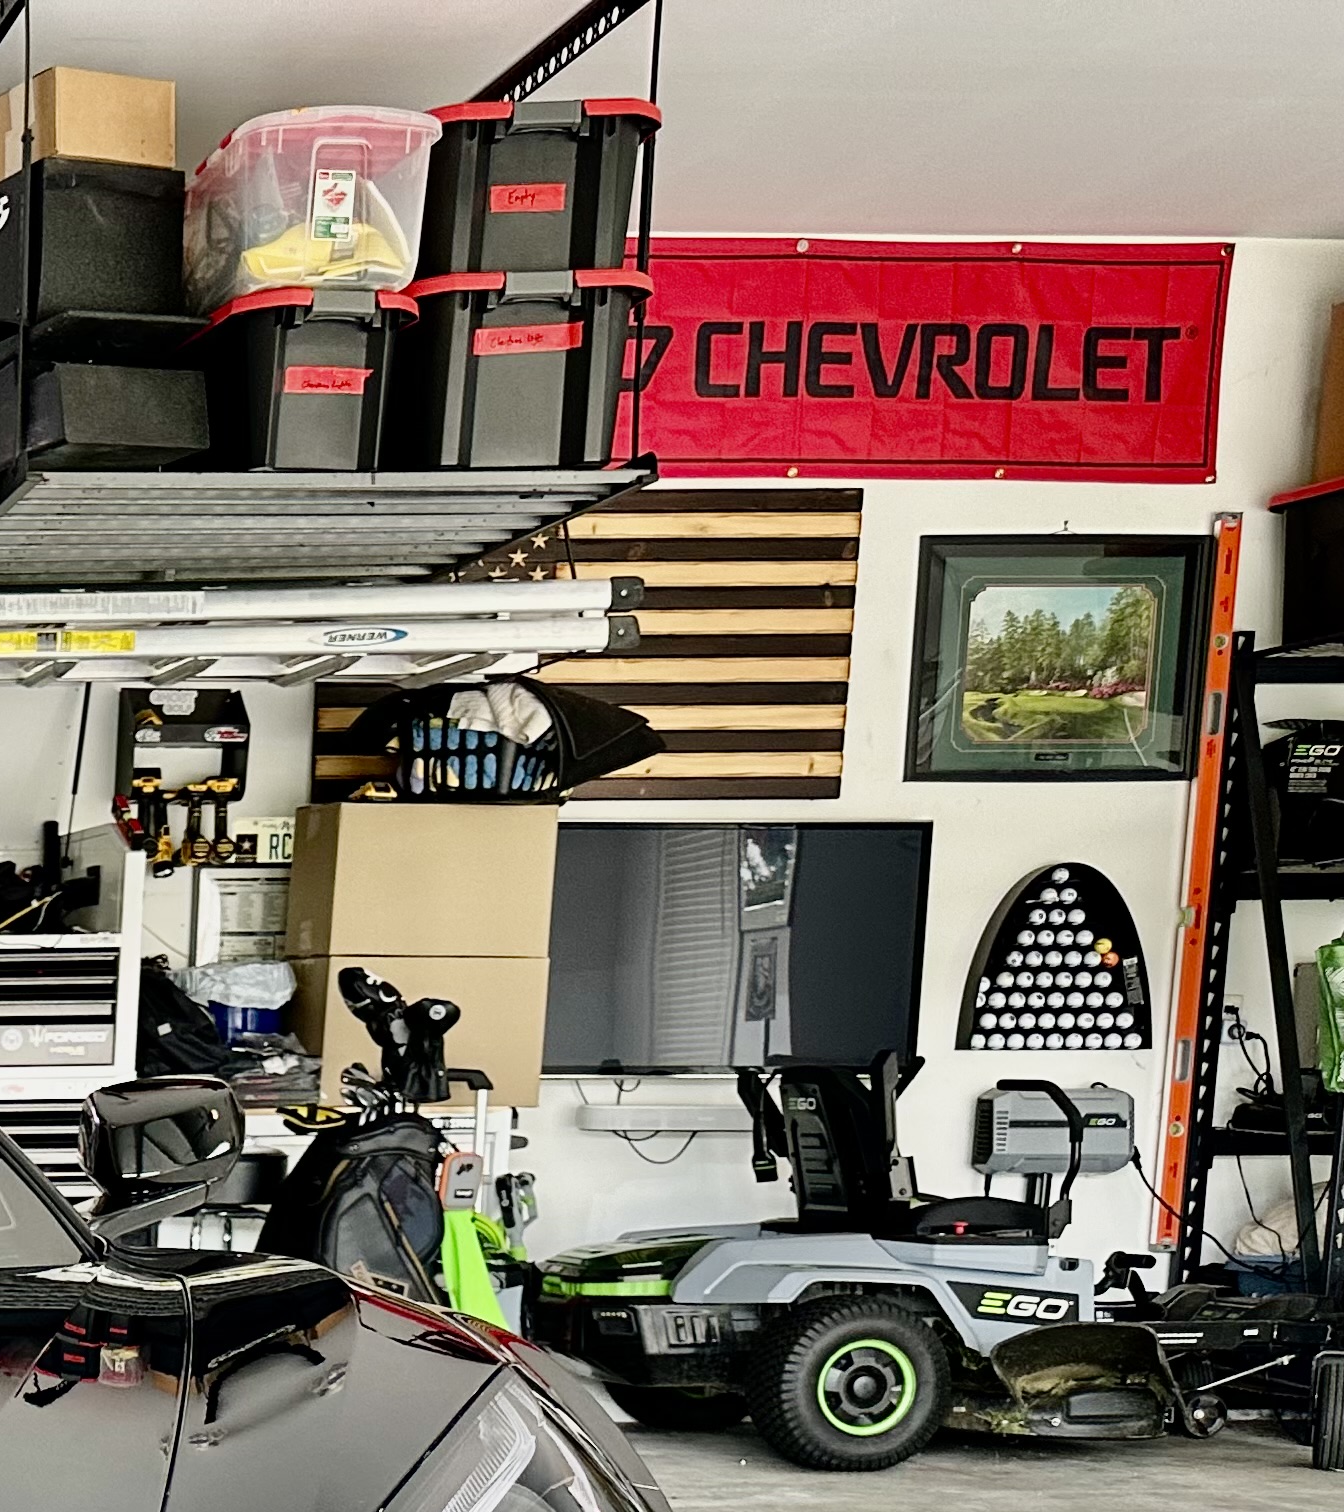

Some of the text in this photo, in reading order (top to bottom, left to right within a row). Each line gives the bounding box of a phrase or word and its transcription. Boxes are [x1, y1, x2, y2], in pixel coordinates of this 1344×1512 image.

[695, 321, 1180, 402] CHEVROLET
[327, 632, 388, 643] WERNER
[1293, 745, 1343, 756] EGO
[787, 1097, 816, 1111] EGO
[1089, 1114, 1117, 1126] EGO
[977, 1291, 1070, 1321] EGO
